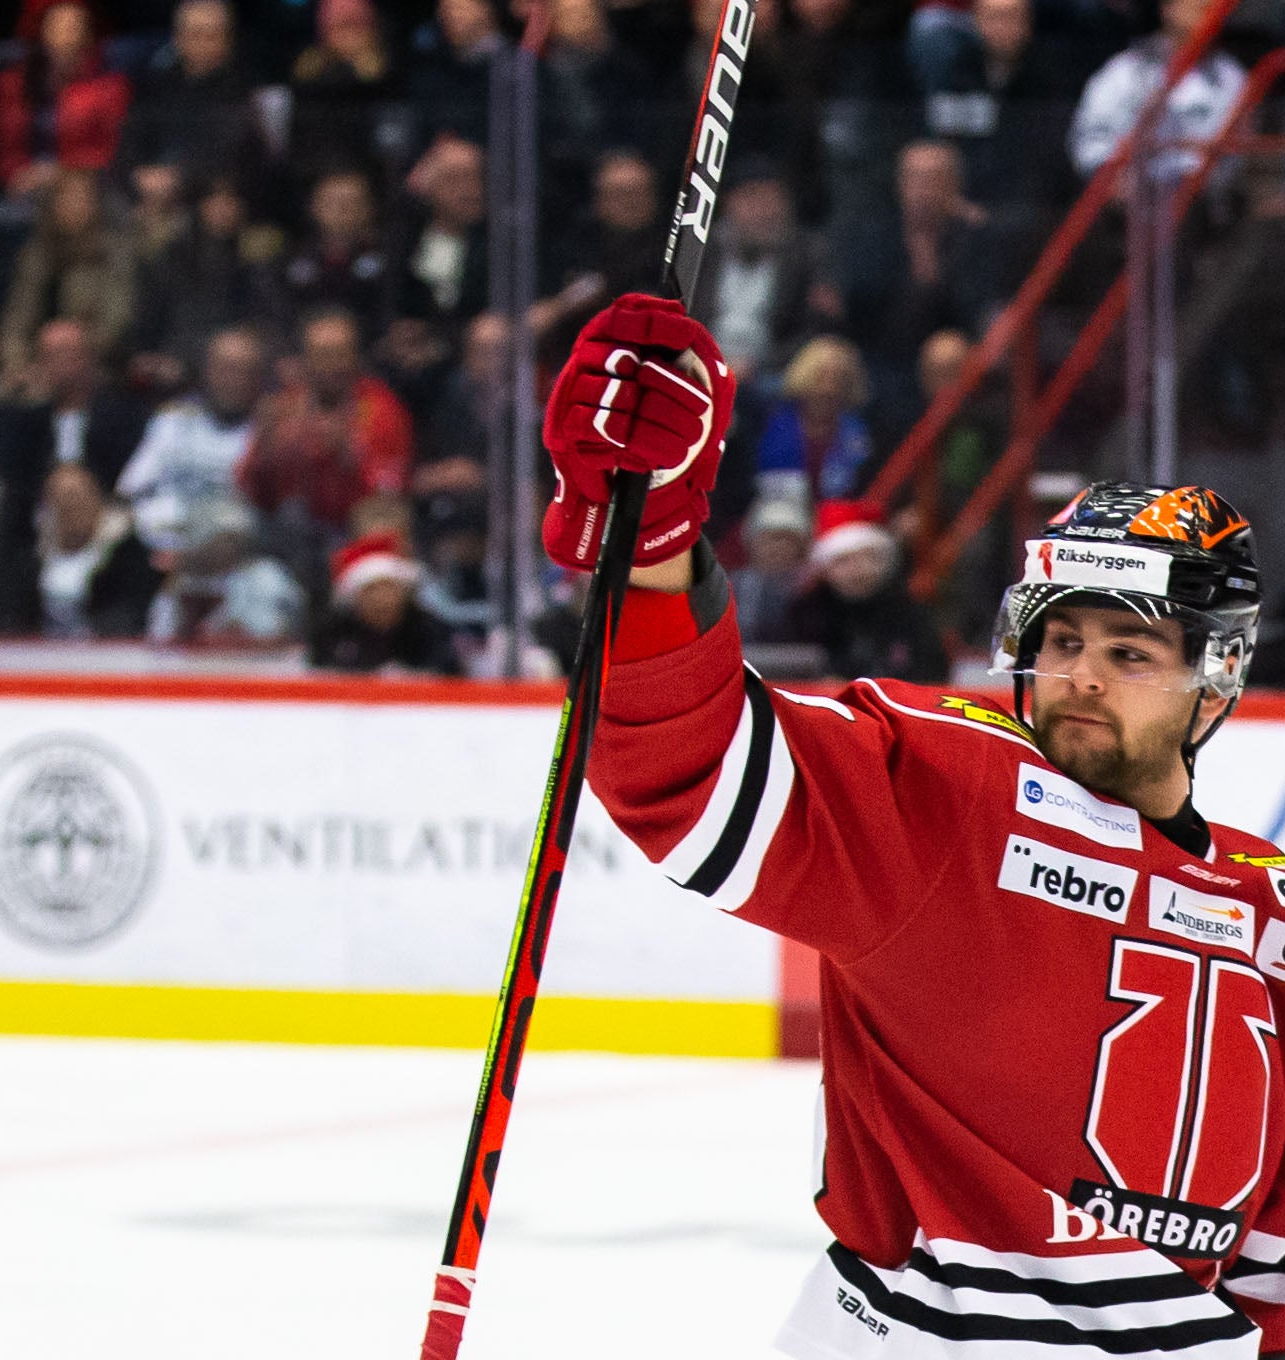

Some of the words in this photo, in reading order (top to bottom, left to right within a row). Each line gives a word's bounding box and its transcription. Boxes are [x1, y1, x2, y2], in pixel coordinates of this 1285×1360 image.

[1056, 549, 1146, 570] Riksbyggen
[1025, 784, 1042, 801] LG
[1045, 792, 1137, 834] CONTRACTING
[1162, 891, 1244, 939] LINDBERGS
[1085, 1188, 1238, 1252] ÖREBRO
